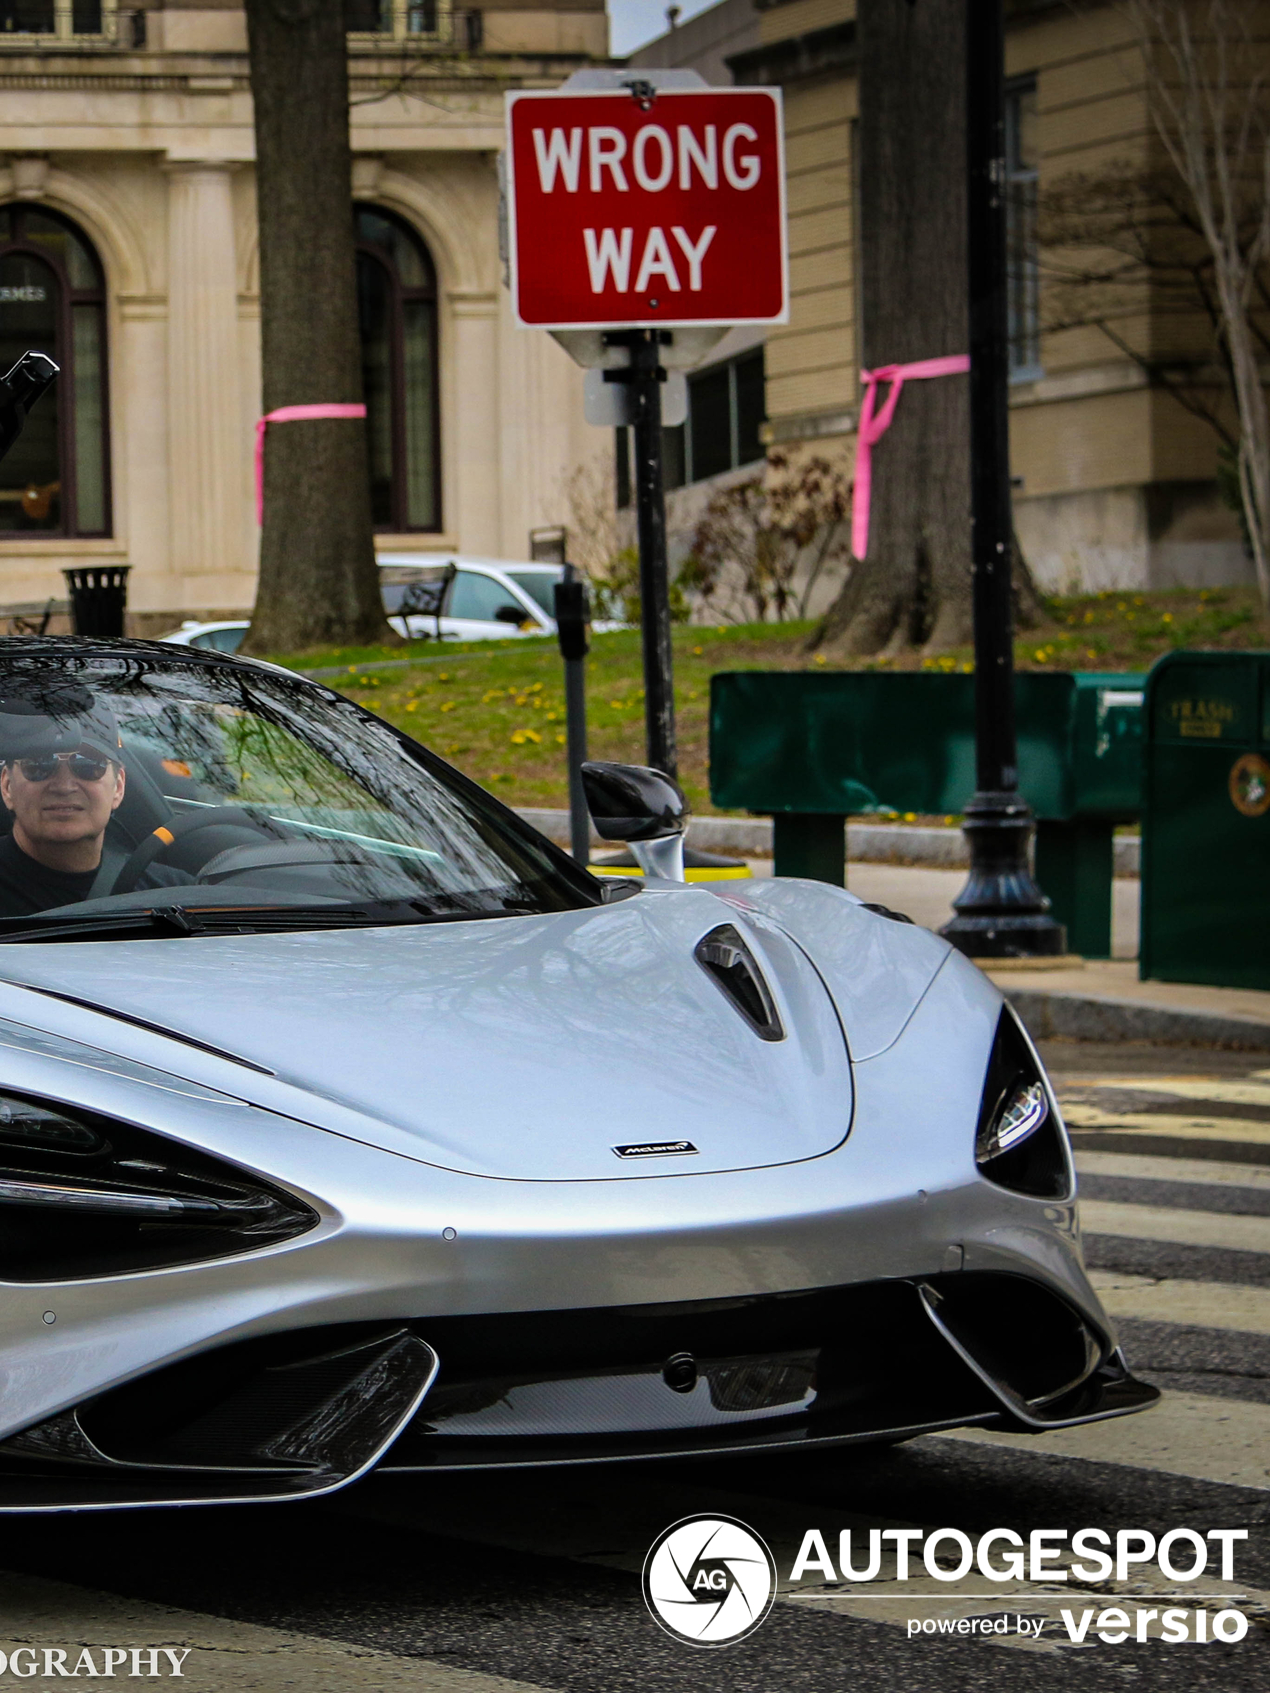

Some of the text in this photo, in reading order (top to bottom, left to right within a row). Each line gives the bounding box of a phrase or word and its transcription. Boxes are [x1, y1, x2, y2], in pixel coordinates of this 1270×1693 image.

[533, 123, 761, 193] WRONG
[583, 226, 717, 294] WAY
[624, 1143, 687, 1154] McLaren
